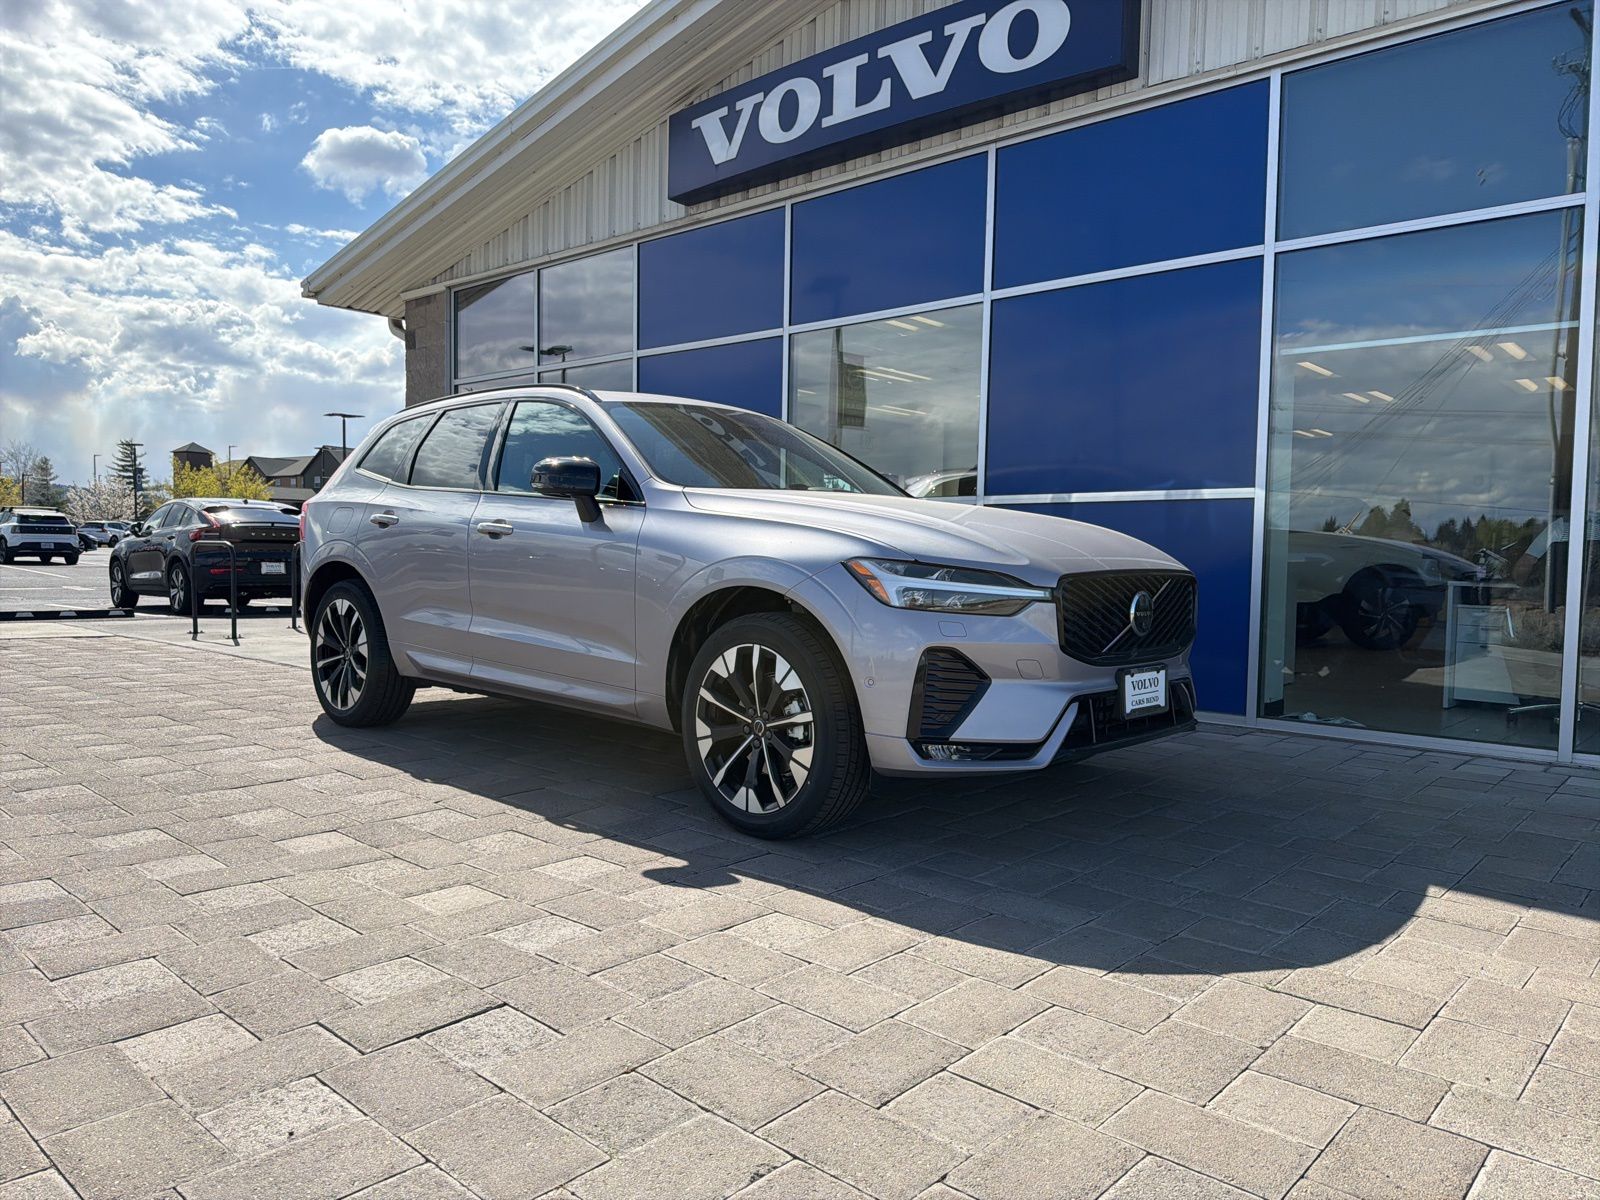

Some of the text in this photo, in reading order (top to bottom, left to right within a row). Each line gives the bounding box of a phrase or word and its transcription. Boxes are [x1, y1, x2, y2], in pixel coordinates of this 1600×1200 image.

[691, 0, 1071, 165] VOLVO
[1131, 677, 1159, 691] VOLVO
[1131, 698, 1145, 706] CARS
